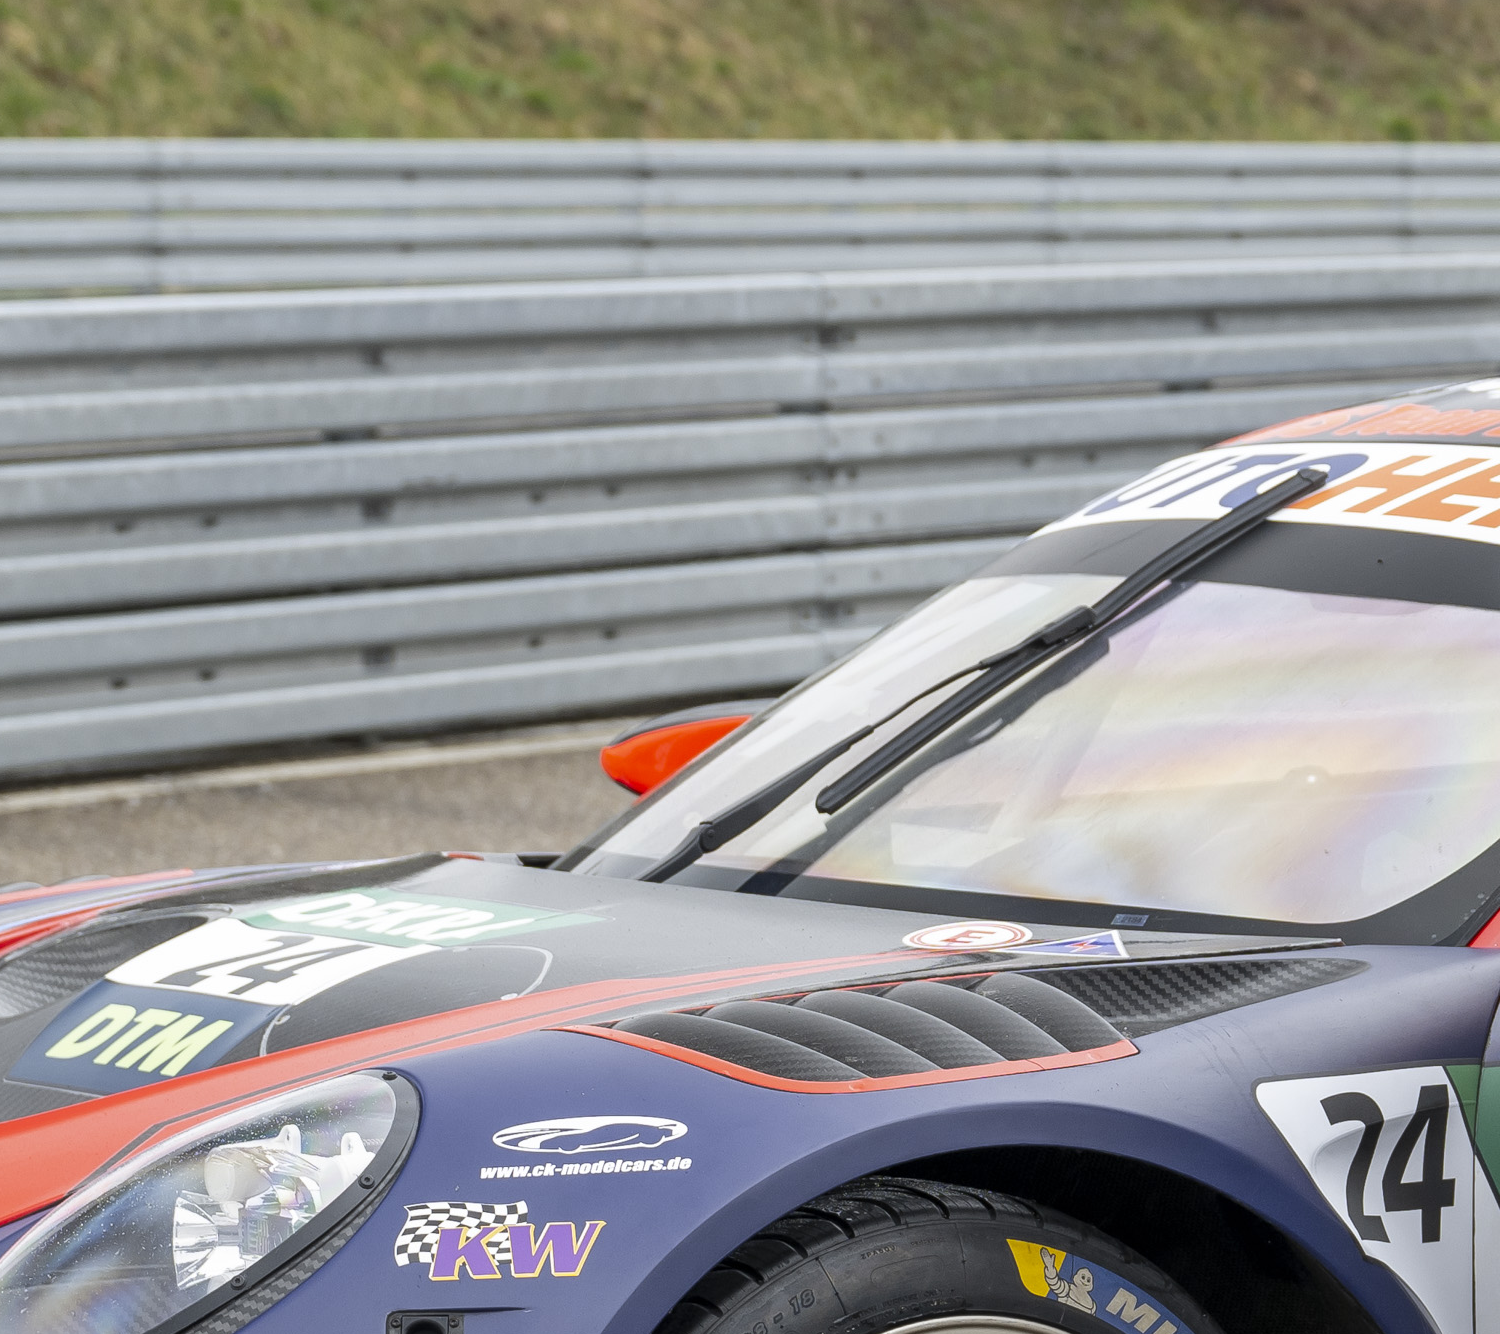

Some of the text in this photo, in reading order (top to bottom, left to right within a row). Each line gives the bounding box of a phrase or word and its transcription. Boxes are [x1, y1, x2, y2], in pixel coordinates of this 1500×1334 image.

[155, 934, 374, 996] 24
[45, 1002, 235, 1078] DTM
[480, 1155, 692, 1179] www.ck-modelcars.de
[1320, 1085, 1456, 1245] 24
[429, 1220, 607, 1282] KW
